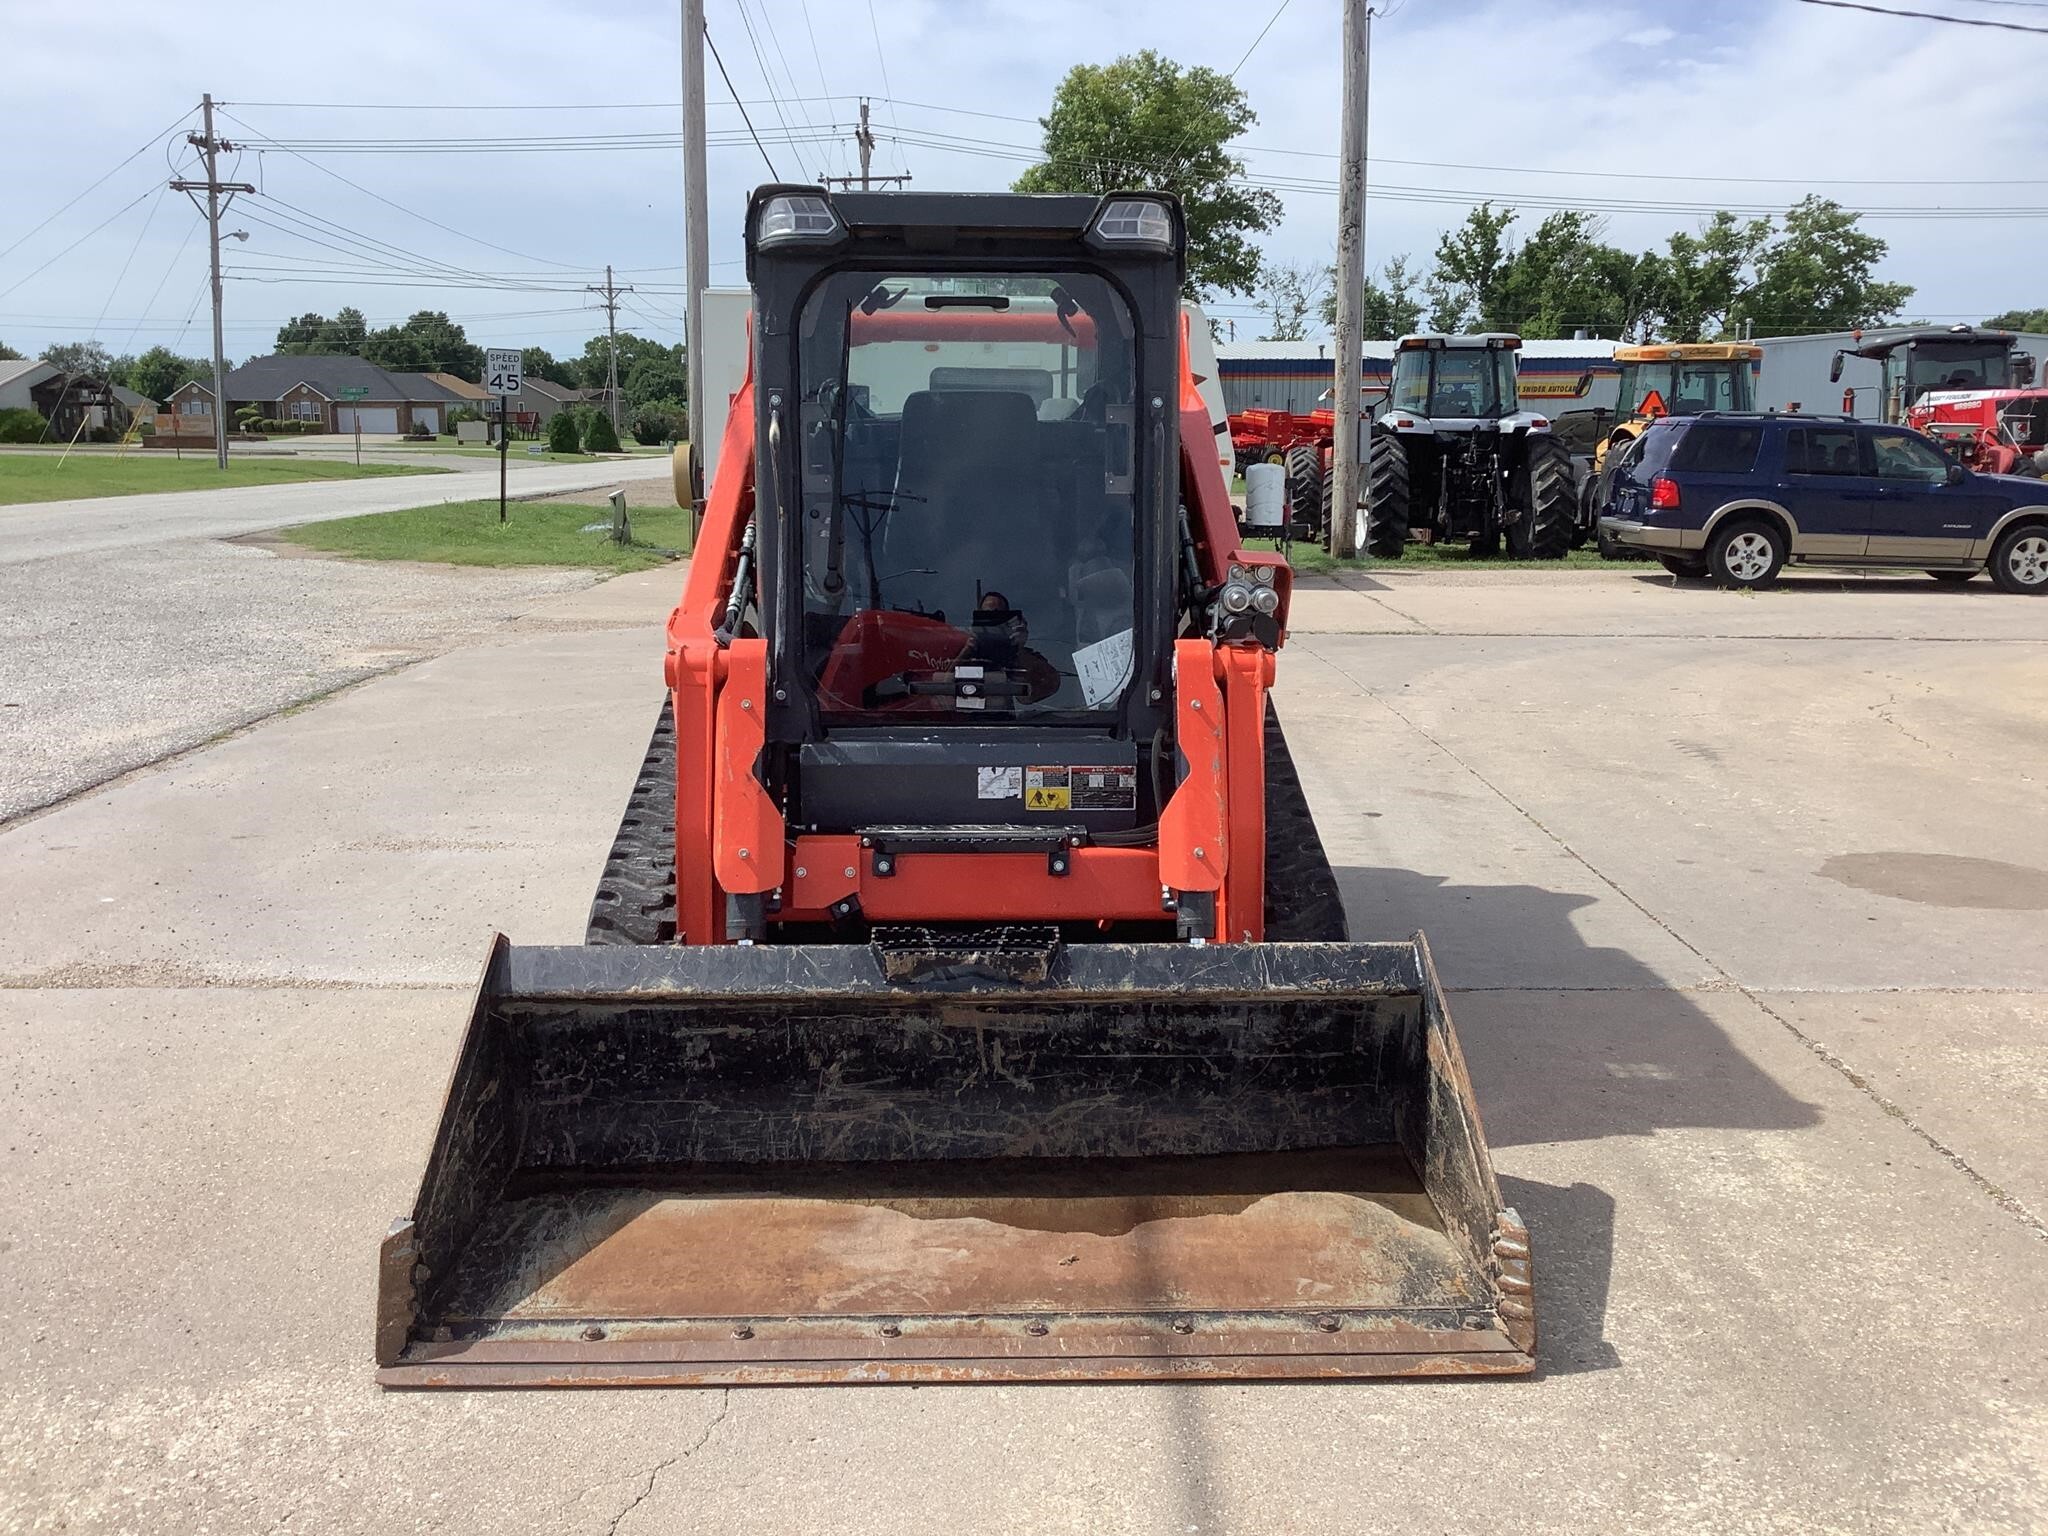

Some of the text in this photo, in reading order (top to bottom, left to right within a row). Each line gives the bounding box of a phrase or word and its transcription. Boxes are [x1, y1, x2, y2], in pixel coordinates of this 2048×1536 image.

[490, 354, 520, 362] SPEED
[493, 364, 516, 372] LIMIT
[490, 373, 519, 390] 45
[1522, 385, 1546, 393] SNIDER
